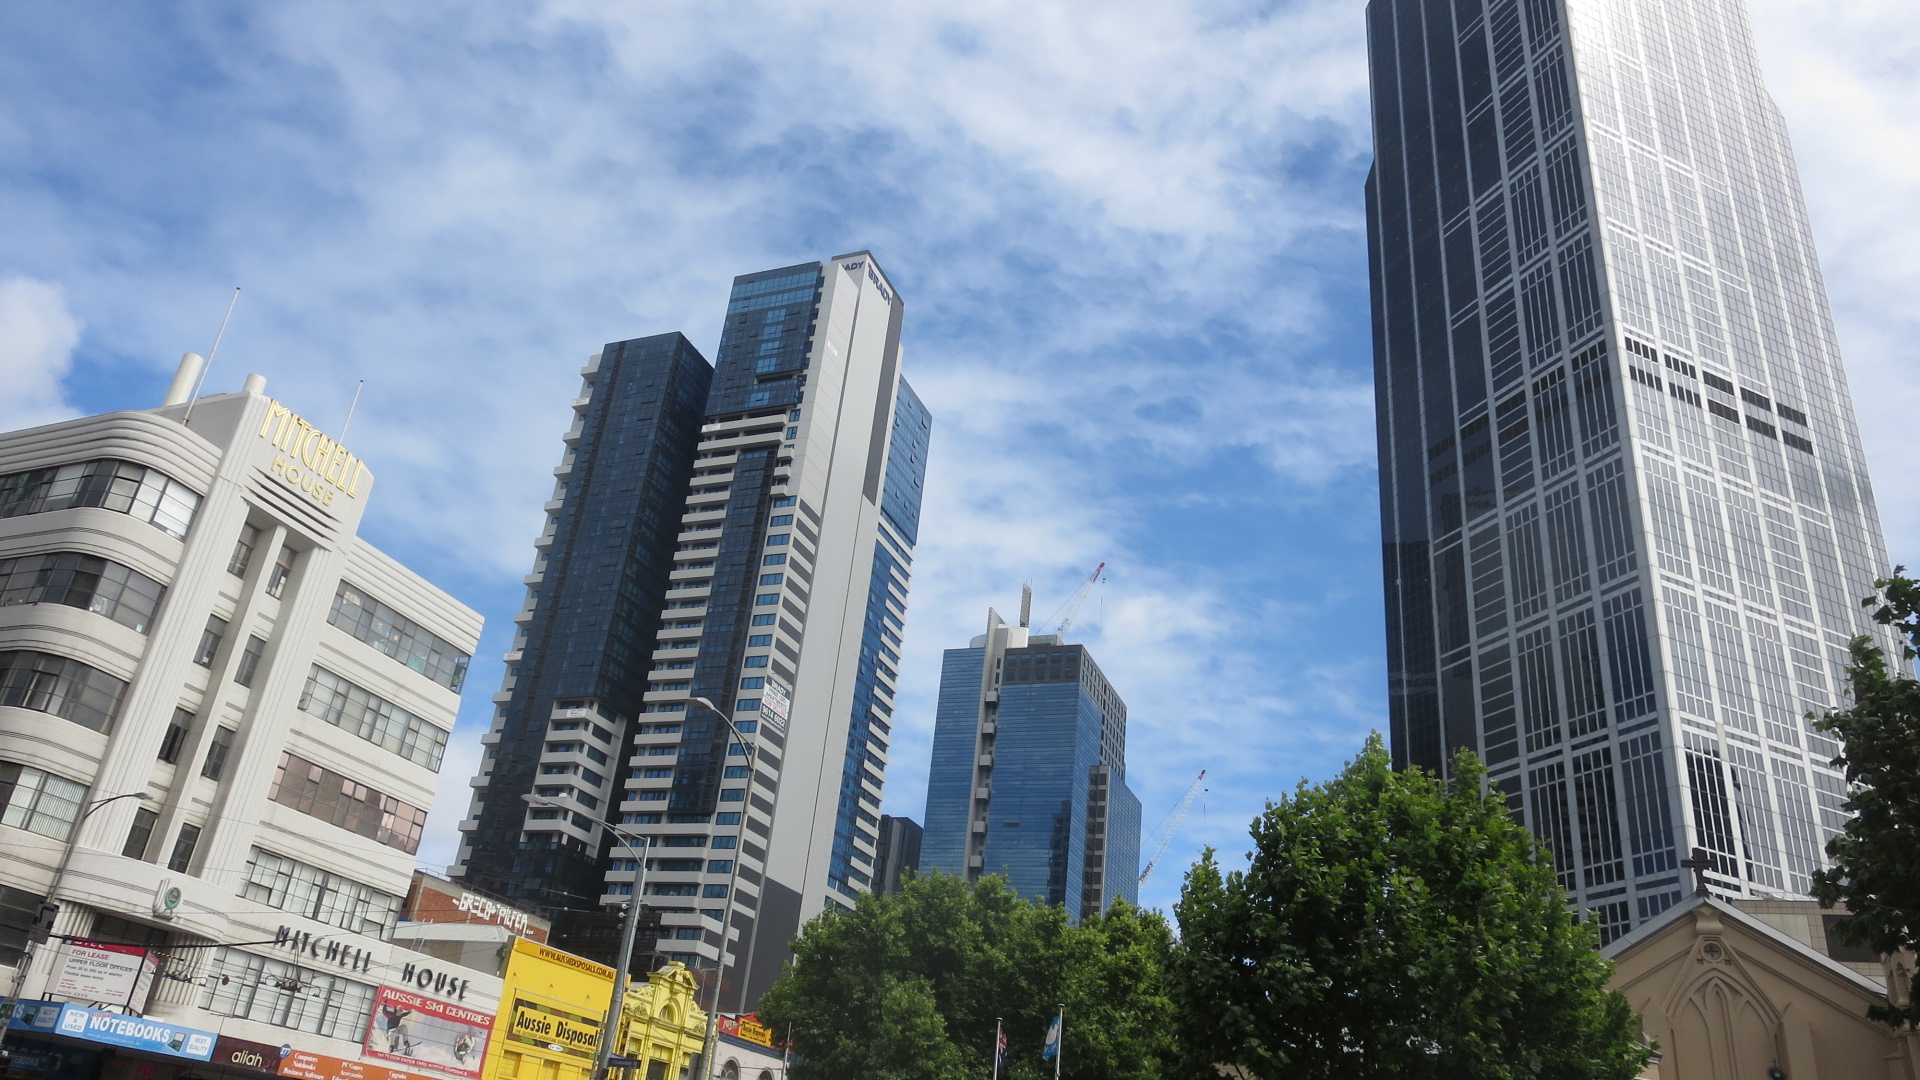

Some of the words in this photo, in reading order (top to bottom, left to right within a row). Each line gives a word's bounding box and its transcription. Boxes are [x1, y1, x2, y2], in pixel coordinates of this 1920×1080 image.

[843, 261, 864, 271] ADY
[258, 399, 363, 499] MITCHELL
[271, 455, 335, 507] HOUSE
[71, 949, 87, 957] FOR
[87, 951, 110, 961] LEASE
[273, 924, 372, 972] MITCHELL
[401, 962, 470, 1001] HOUSE
[539, 947, 614, 980] WWW.AUSSIEDISPOSALS.COM.AU
[382, 989, 424, 1008] AUSSIE
[445, 1006, 491, 1026] CENTRES
[69, 1010, 86, 1019] NEW
[63, 1023, 83, 1031] USED
[515, 1010, 552, 1036] Aussie
[89, 1016, 171, 1043] NOTEBOOKS
[194, 1037, 208, 1046] BEST
[188, 1043, 208, 1054] QUALITY
[231, 1049, 263, 1068] aliah
[294, 1052, 318, 1064] Computers
[384, 1053, 400, 1062] FLOOR
[400, 1057, 416, 1065] ENTER
[291, 1060, 317, 1071] Notebooks
[282, 1067, 303, 1077] Business
[304, 1070, 325, 1080] Software
